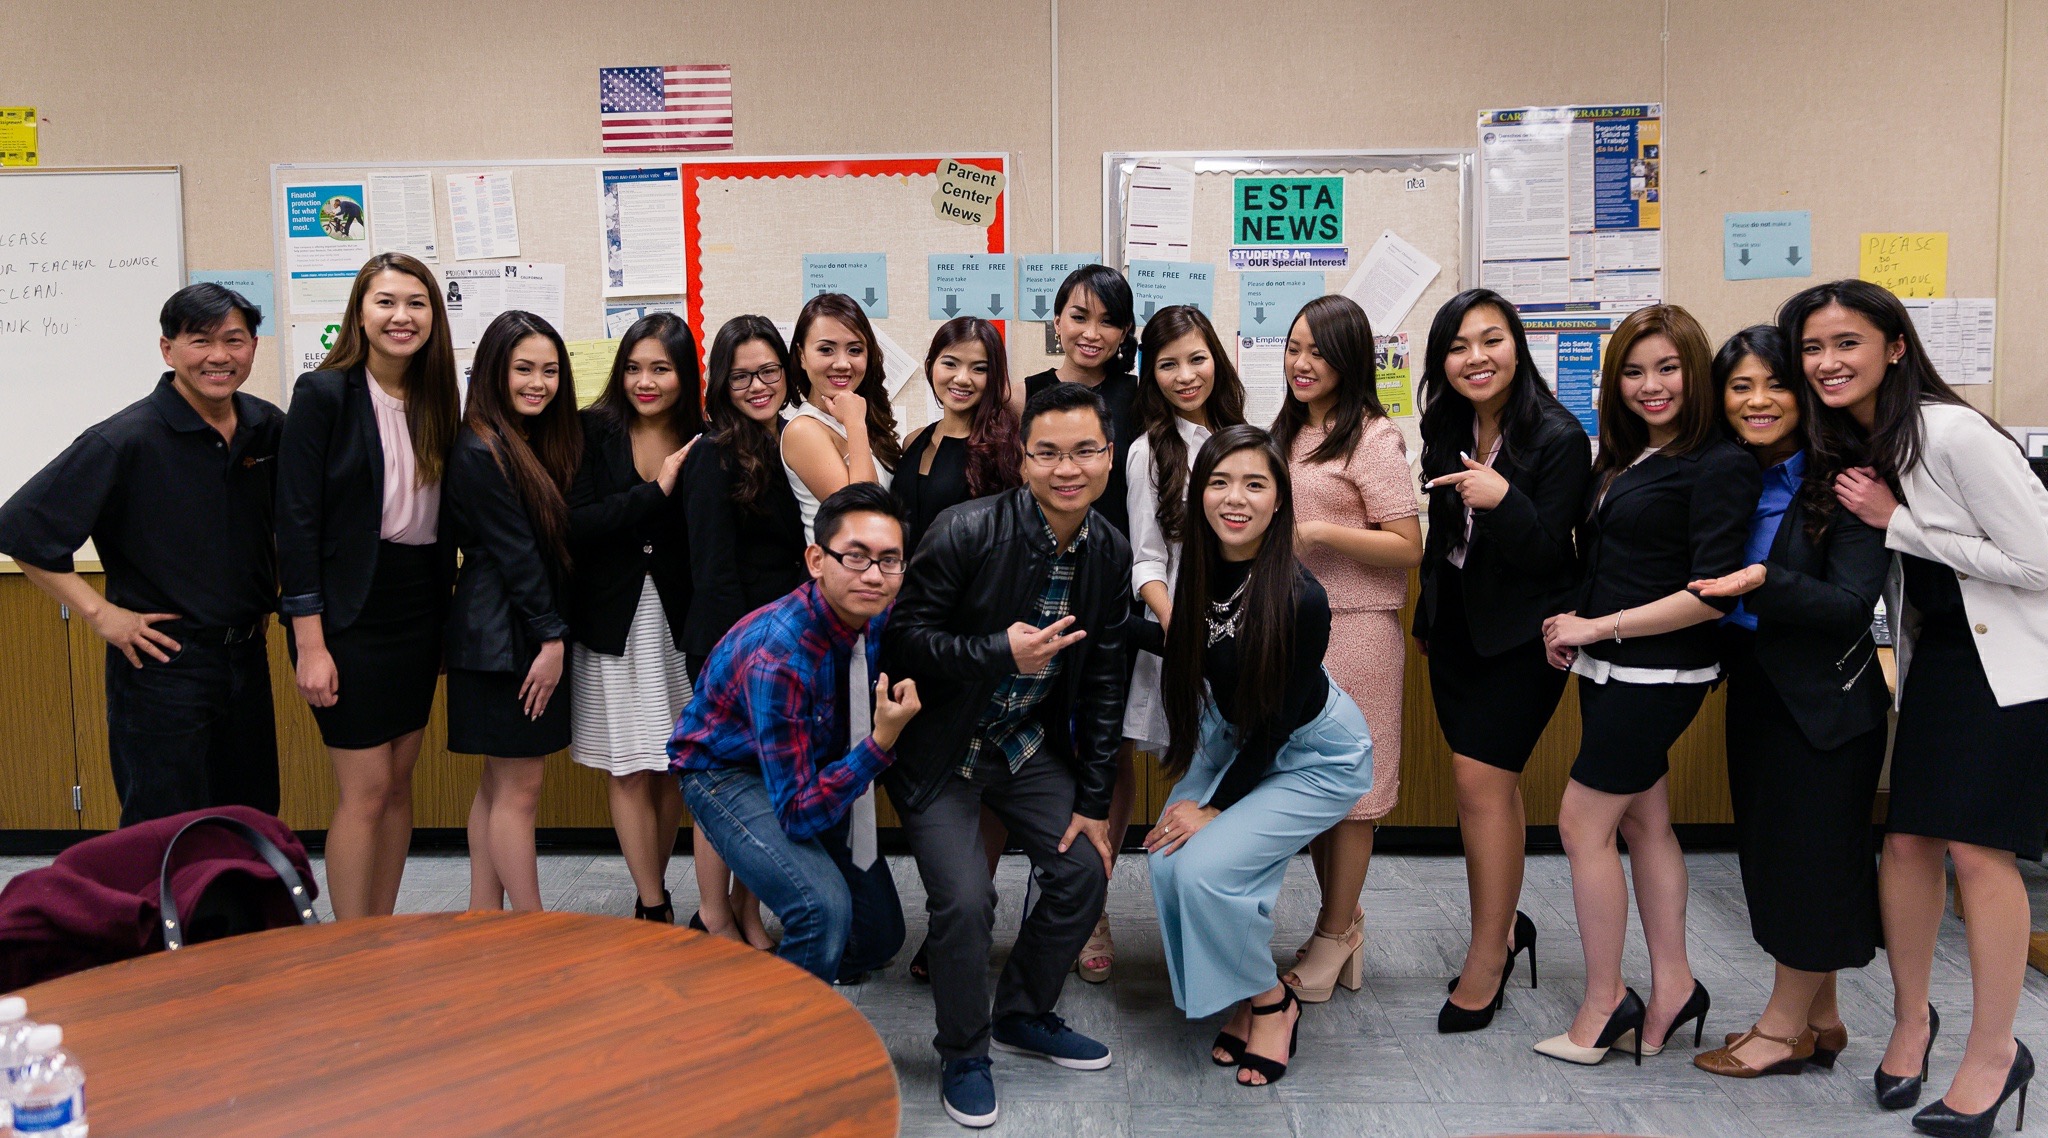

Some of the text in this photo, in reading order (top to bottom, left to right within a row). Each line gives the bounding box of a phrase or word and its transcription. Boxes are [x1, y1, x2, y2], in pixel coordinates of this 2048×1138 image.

[1621, 107, 1641, 117] 2012
[1595, 125, 1630, 133] Seguridad
[946, 162, 997, 187] Parent
[1406, 177, 1425, 189] nea
[290, 191, 317, 199] Financial
[942, 182, 992, 205] Center
[1244, 183, 1335, 211] ESTA
[291, 199, 321, 208] protection
[940, 201, 982, 223] News
[1242, 214, 1338, 242] NEWS
[1868, 236, 1937, 255] PLEASE
[1232, 249, 1312, 260] STUDENTS Are
[29, 260, 96, 273] TEACHER
[108, 256, 159, 269] LOUNGE
[1026, 264, 1044, 272] FREE
[1248, 258, 1346, 269] OUR Special Interest
[1873, 263, 1900, 274] NOT
[1138, 270, 1155, 278] FREE
[1162, 271, 1180, 279] FREE
[1556, 320, 1597, 329] POSTINGS
[304, 352, 328, 360] ELEC
[303, 361, 320, 369] REC
